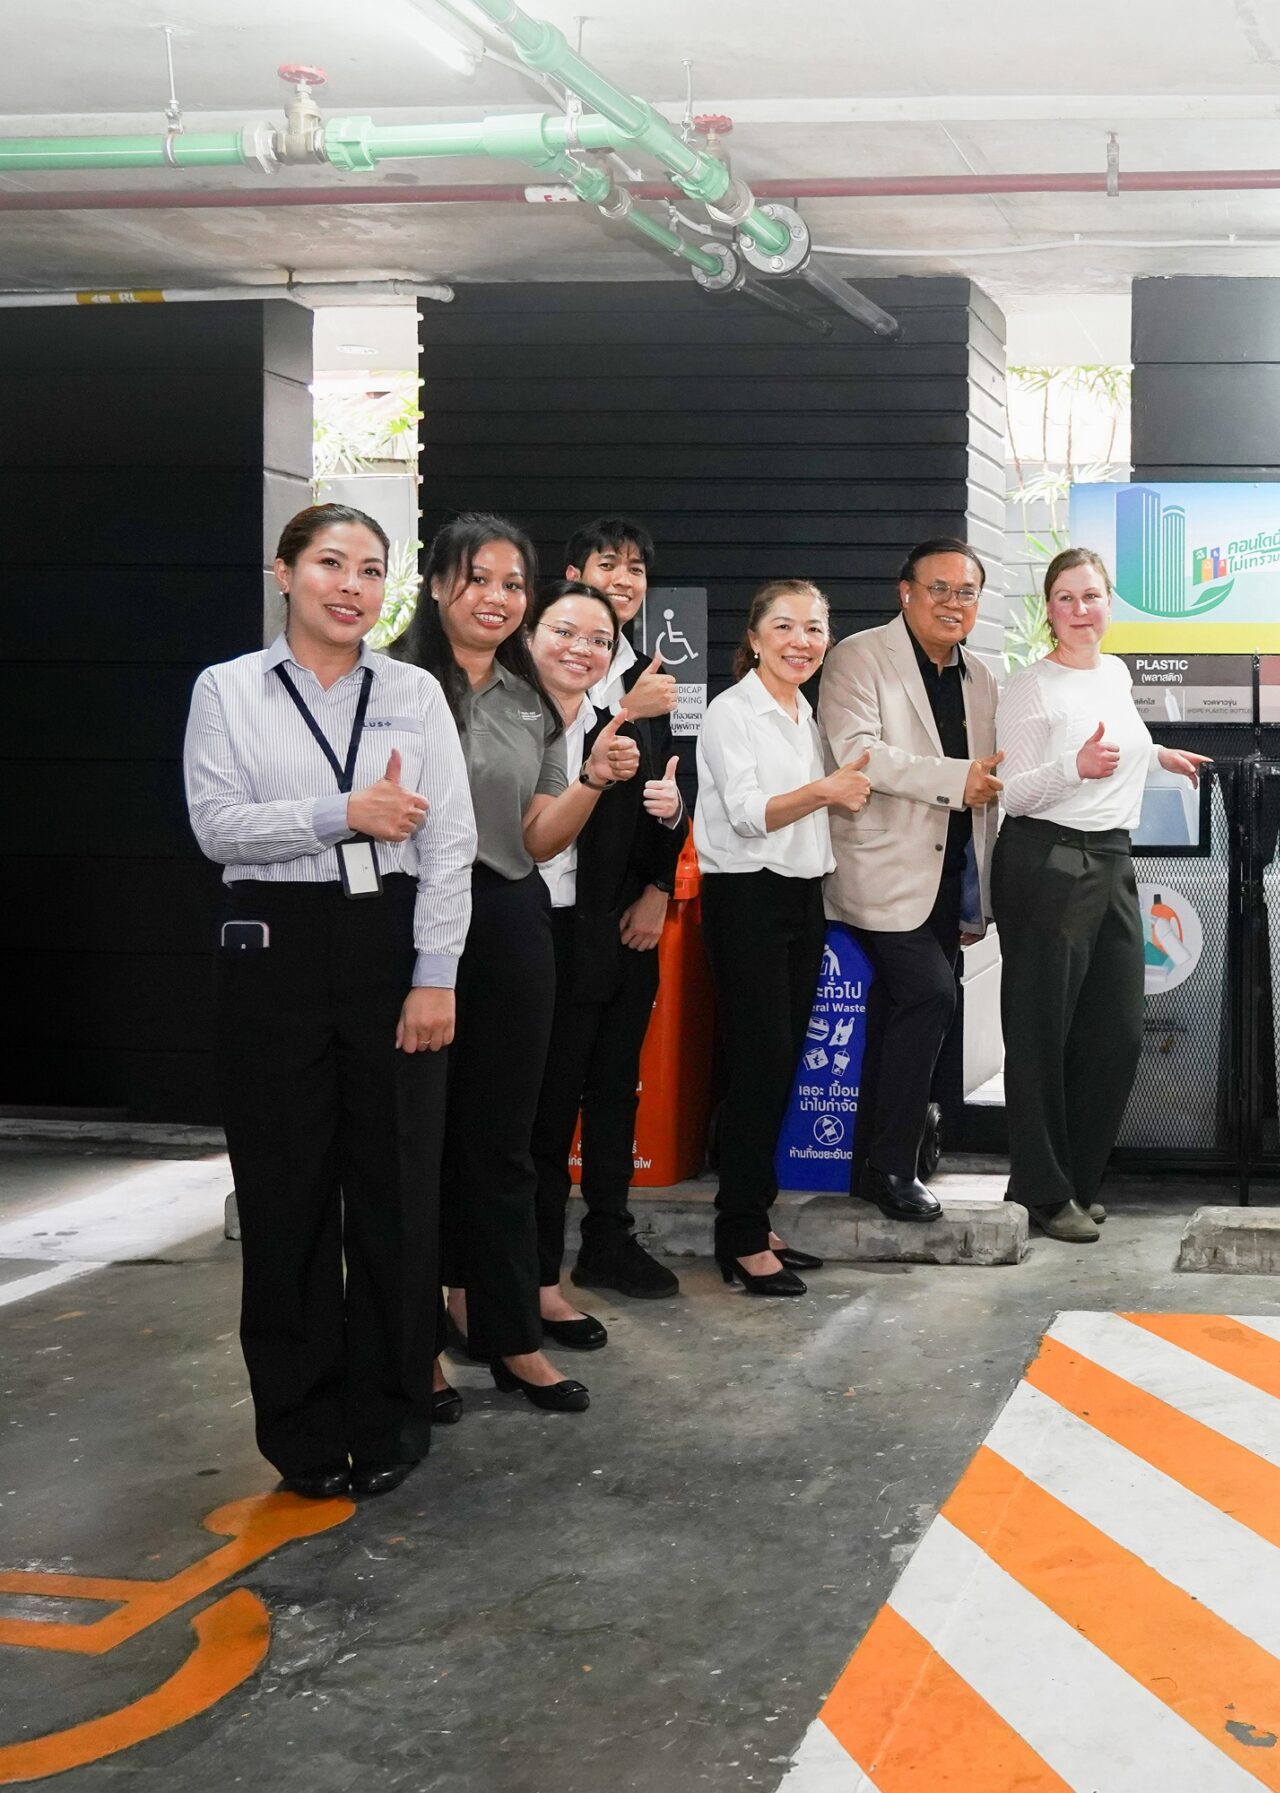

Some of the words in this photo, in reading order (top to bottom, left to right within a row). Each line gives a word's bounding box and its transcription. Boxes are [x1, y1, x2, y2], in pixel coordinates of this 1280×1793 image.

[1135, 659, 1189, 671] PLASTIC
[1141, 672, 1183, 684] (พลาสติก)
[678, 686, 703, 694] DICAP
[676, 697, 703, 705] RKING
[832, 1003, 866, 1013] Waste
[798, 1085, 825, 1097] เลอะ
[828, 1080, 859, 1097] เปื้อน
[800, 1097, 858, 1112] นำไปกำจัด
